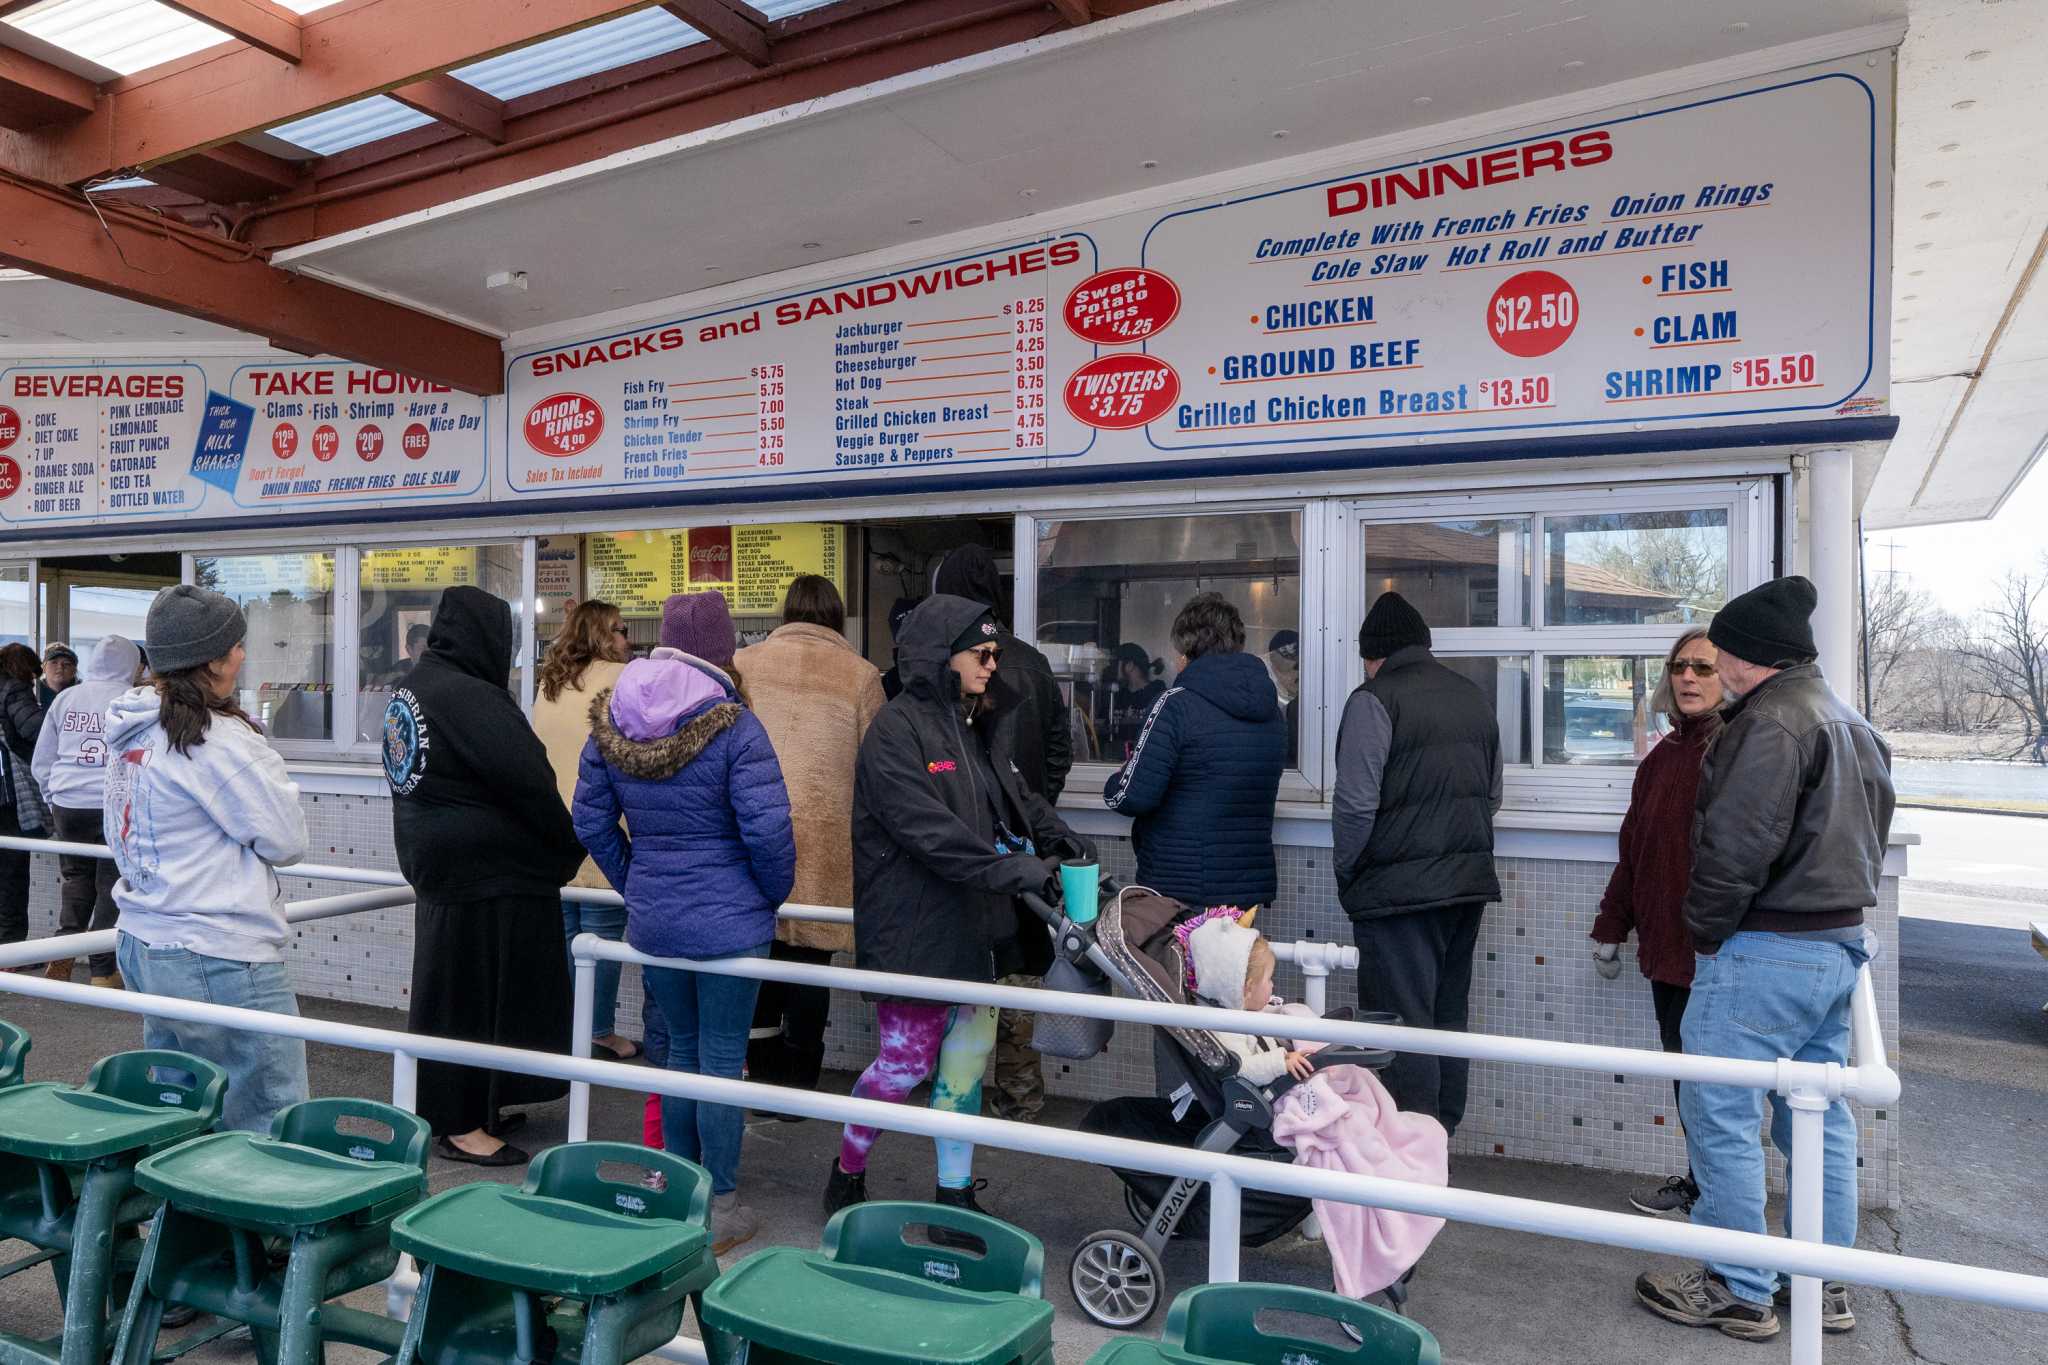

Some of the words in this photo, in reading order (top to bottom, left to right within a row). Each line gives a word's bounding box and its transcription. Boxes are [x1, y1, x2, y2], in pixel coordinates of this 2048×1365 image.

[1326, 129, 1614, 218] DINNERS
[1255, 227, 1361, 260] Complete
[1370, 220, 1425, 246] With
[1431, 209, 1516, 238] French
[1524, 202, 1590, 227] Fries
[1609, 191, 1686, 219] Onion
[1696, 181, 1774, 208] Rings
[1310, 257, 1363, 282] Cole
[1370, 252, 1430, 275] Slaw
[1446, 245, 1491, 268] Hot
[1498, 236, 1551, 262] Roll
[1557, 230, 1608, 255] and
[1613, 221, 1704, 250] Butter
[1661, 259, 1729, 293] FISH
[1075, 273, 1147, 304] Sweet
[532, 328, 685, 377] SNACKS
[699, 312, 761, 342] and
[776, 240, 1081, 326] SANDWICHES
[1073, 289, 1148, 318] Potato
[1265, 295, 1374, 330] CHICKEN
[1495, 291, 1574, 337] $12.50
[1083, 305, 1139, 329] Fries
[1112, 317, 1153, 336] $4.25
[1653, 310, 1738, 345] CLAM
[835, 339, 899, 356] Hamburger
[1016, 318, 1044, 334] 3.75
[836, 320, 903, 339] Jackburger
[835, 355, 917, 374] Cheeseburger
[1016, 337, 1045, 353] 4.25
[1223, 346, 1336, 381] GROUND
[1350, 338, 1421, 370] BEEF
[249, 371, 334, 396] TAKE
[835, 378, 855, 392] Hot
[860, 375, 882, 391] Dog
[1016, 355, 1045, 372] 3.50
[1073, 368, 1169, 397] TWISTERS
[1605, 363, 1722, 400] SHRIMP
[1732, 353, 1815, 388] $15.50
[14, 375, 184, 398] BEVERAGES
[623, 382, 645, 395] Fish
[648, 379, 665, 394] Fry
[623, 399, 648, 412] Clam
[652, 397, 668, 411] Fry
[760, 382, 784, 398] 5.75
[835, 396, 869, 412] Steak
[1017, 374, 1044, 390] 6.75
[110, 405, 131, 419] PINK
[135, 399, 184, 417] LEMONADE
[209, 405, 231, 417] THICK
[267, 401, 303, 419] Clams
[313, 401, 338, 420] Fish
[350, 401, 395, 420] Shrimp
[409, 402, 437, 417] Have
[441, 402, 449, 414] a
[530, 398, 581, 426] ONION
[623, 416, 659, 430] Shrimp
[663, 413, 680, 428] Fry
[760, 399, 784, 415] 7.00
[835, 412, 878, 431] Grilled
[884, 408, 936, 428] Chicken
[943, 403, 989, 423] Breast
[1016, 394, 1044, 410] 5.75
[1089, 393, 1145, 417] $3.75
[1178, 399, 1256, 430] Grilled
[1267, 393, 1366, 423] Chicken
[1379, 383, 1469, 416] Breast
[1479, 375, 1550, 407] $13.50
[35, 413, 57, 428] COKE
[110, 419, 158, 437] LEMONADE
[219, 418, 237, 430] RICH
[429, 415, 455, 432] Nice
[458, 414, 481, 431] Day
[544, 410, 596, 438] RINGS
[623, 433, 665, 447] Chicken
[668, 430, 703, 445] Tender
[760, 417, 785, 432] 5.50
[836, 433, 874, 450] Veggie
[879, 430, 920, 447] Burger
[1017, 413, 1045, 429] 4.75
[34, 430, 54, 444] DIET
[56, 428, 79, 442] COKE
[110, 439, 135, 455] FRUIT
[139, 436, 170, 452] PUNCH
[204, 434, 235, 451] MILK
[404, 434, 427, 449] FREE
[35, 448, 40, 461] 7
[43, 447, 54, 461] UP
[623, 451, 659, 464] French
[662, 449, 688, 462] Fries
[760, 435, 784, 450] 3.75
[835, 451, 885, 467] Sausage
[890, 449, 898, 462] &
[904, 446, 953, 462] Peppers
[1016, 432, 1044, 448] 5.75
[34, 464, 68, 479] ORANGE
[71, 462, 95, 476] SODA
[110, 455, 157, 472] GATORADE
[194, 453, 241, 472] SHAKES
[249, 467, 273, 481] Don't
[275, 464, 305, 479] Forget
[526, 469, 548, 483] Sales
[550, 467, 564, 481] Tax
[567, 464, 603, 479] Included
[623, 466, 649, 480] Fried
[653, 464, 685, 479] Dough
[759, 452, 784, 467] 4.50
[34, 481, 65, 496] GINGER
[68, 480, 84, 494] ALE
[110, 475, 130, 490] ICED
[134, 474, 151, 488] TEA
[261, 482, 291, 496] ONION
[292, 480, 321, 494] RINGS
[328, 476, 365, 491] FRENCH
[367, 474, 396, 489] FRIES
[402, 472, 427, 487] COLE
[430, 470, 461, 485] SLAW
[34, 499, 55, 513] ROOT
[59, 498, 81, 512] BEER
[110, 492, 149, 508] BOTTLED
[153, 490, 185, 505] WATER
[64, 711, 107, 733] SPA
[398, 687, 430, 749] SIBERIAN
